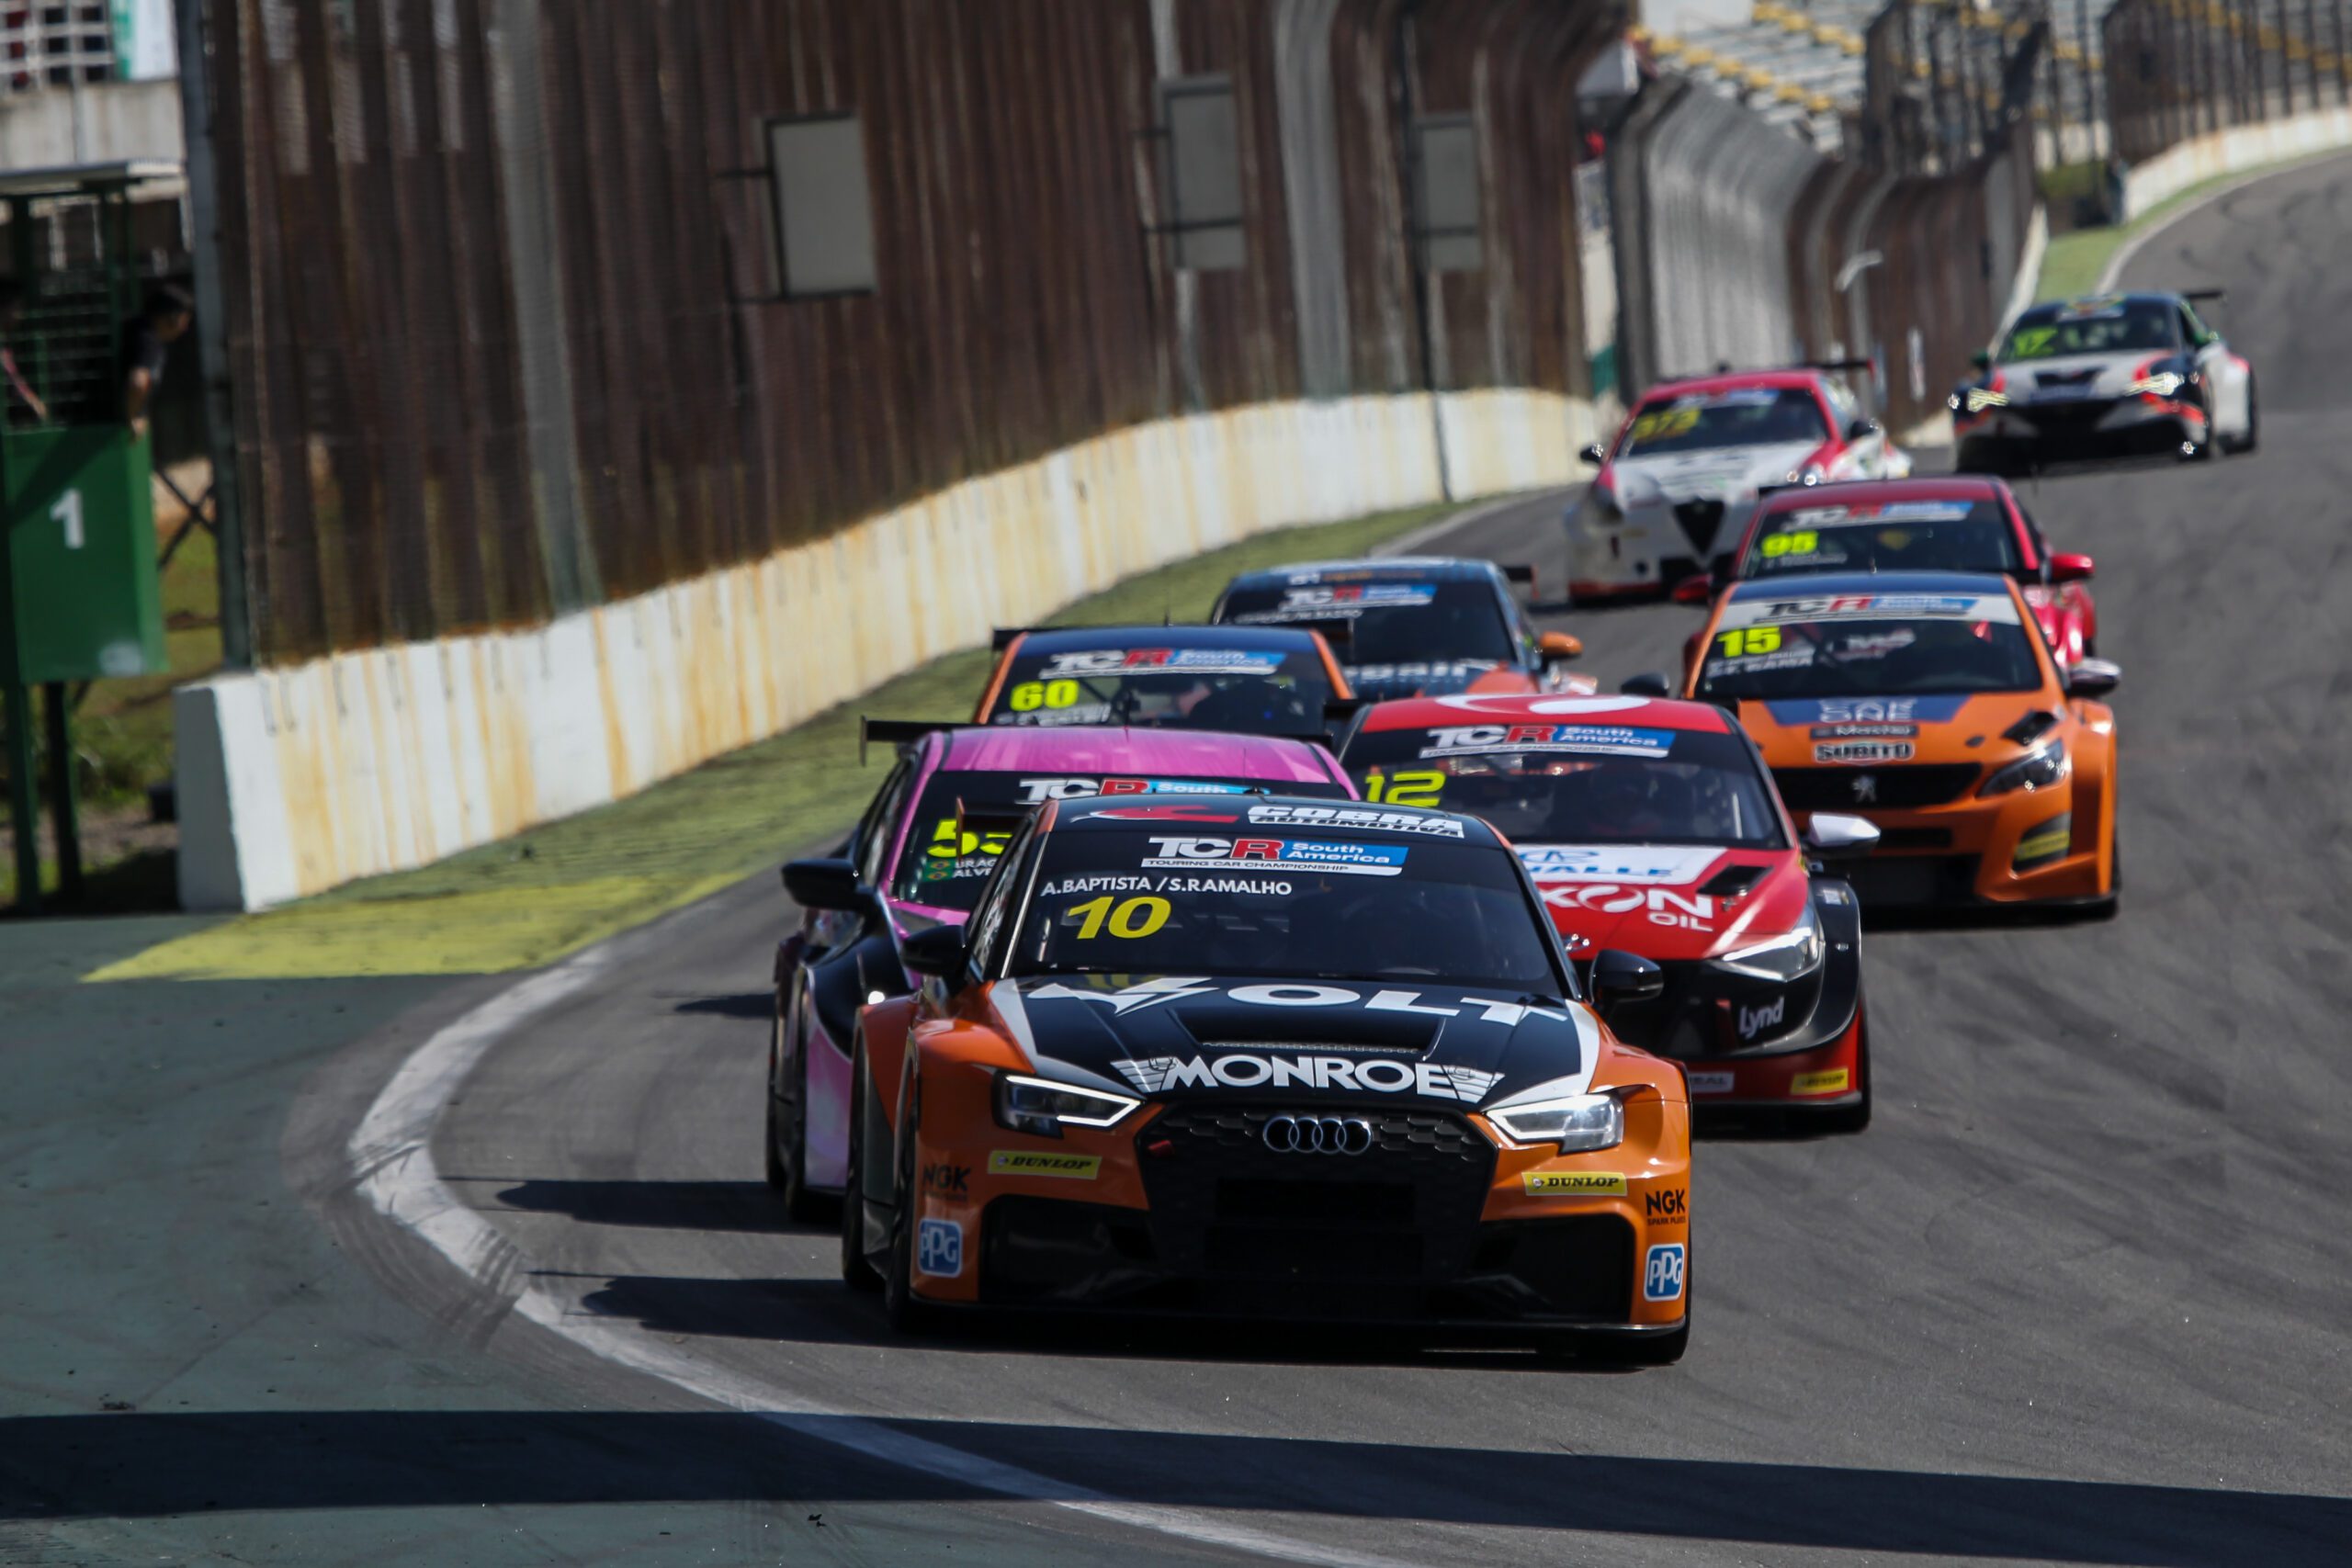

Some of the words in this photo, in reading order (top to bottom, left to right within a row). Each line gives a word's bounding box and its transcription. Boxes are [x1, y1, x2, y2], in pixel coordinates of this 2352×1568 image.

[50, 488, 84, 548] 1
[1766, 594, 1874, 616] TCR
[1717, 626, 1781, 659] 15
[1051, 649, 1173, 671] TCR
[1010, 679, 1080, 711] 60
[1427, 724, 1558, 749] TCR
[1563, 726, 1634, 737] South
[1559, 734, 1658, 746] America
[1019, 778, 1148, 803] TCR
[1158, 782, 1228, 795] South
[1365, 770, 1446, 807] 12
[1248, 806, 1463, 829] COBRA
[1255, 816, 1459, 837] AUTOMOTIVA
[1148, 837, 1284, 861] TCR
[1292, 842, 1364, 854] South
[1286, 851, 1391, 863] America
[1148, 859, 1209, 867] TOURING
[1245, 862, 1349, 872] CHAMPIONSHIP
[1040, 876, 1152, 897] A.BAPTISTA
[1068, 896, 1172, 940] 10
[1648, 911, 1713, 931] OIL
[1162, 1054, 1460, 1100] MONROE
[1011, 1156, 1092, 1170] DUNLOP
[922, 1164, 971, 1192] NGK
[1548, 1177, 1620, 1188] DUNLOP
[1645, 1189, 1686, 1216] NGK
[921, 1226, 957, 1268] PPG
[1648, 1251, 1683, 1294] PPG
